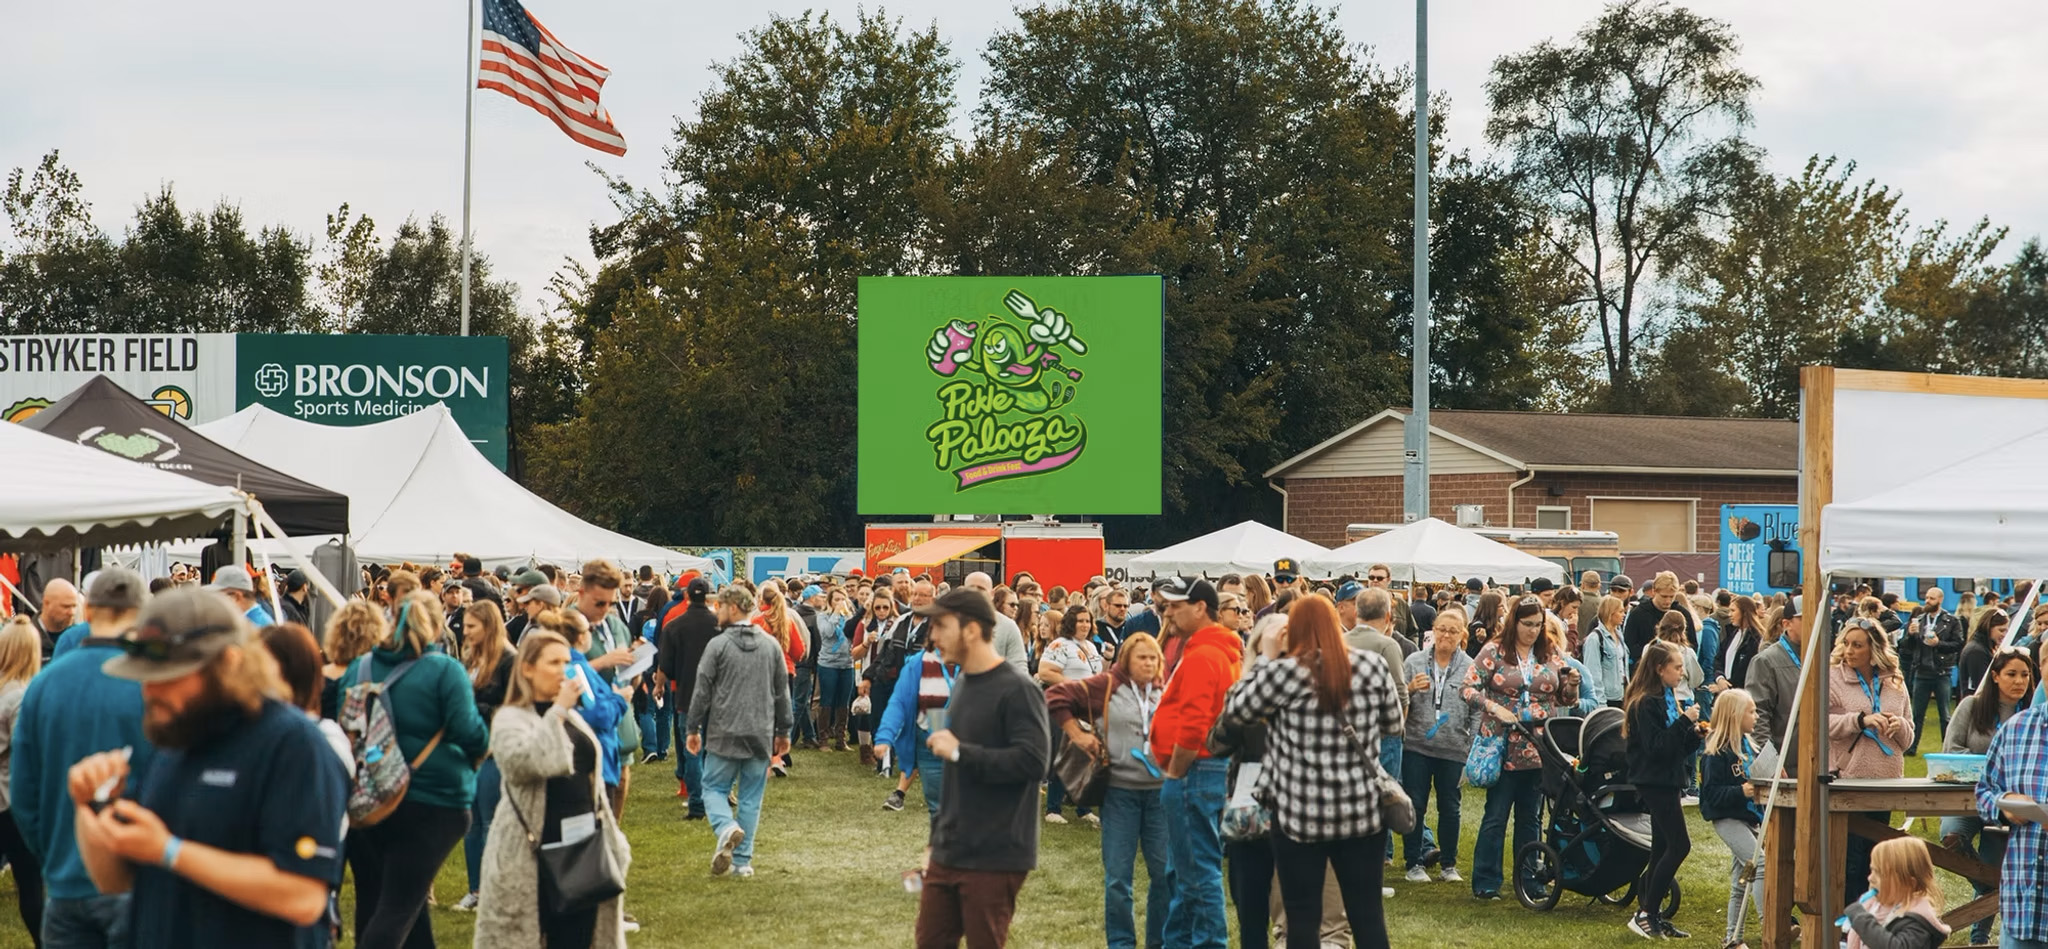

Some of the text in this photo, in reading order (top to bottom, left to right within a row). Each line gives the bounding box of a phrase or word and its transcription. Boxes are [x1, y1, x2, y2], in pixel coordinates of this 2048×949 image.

[124, 337, 198, 372] FIELD
[295, 364, 488, 399] BRONSON
[294, 400, 434, 418] Sports Medicin
[939, 382, 1014, 420] Pickle
[929, 415, 1077, 467] Palooza
[1728, 543, 1755, 562] CHEESE
[1727, 562, 1755, 581] CAKE
